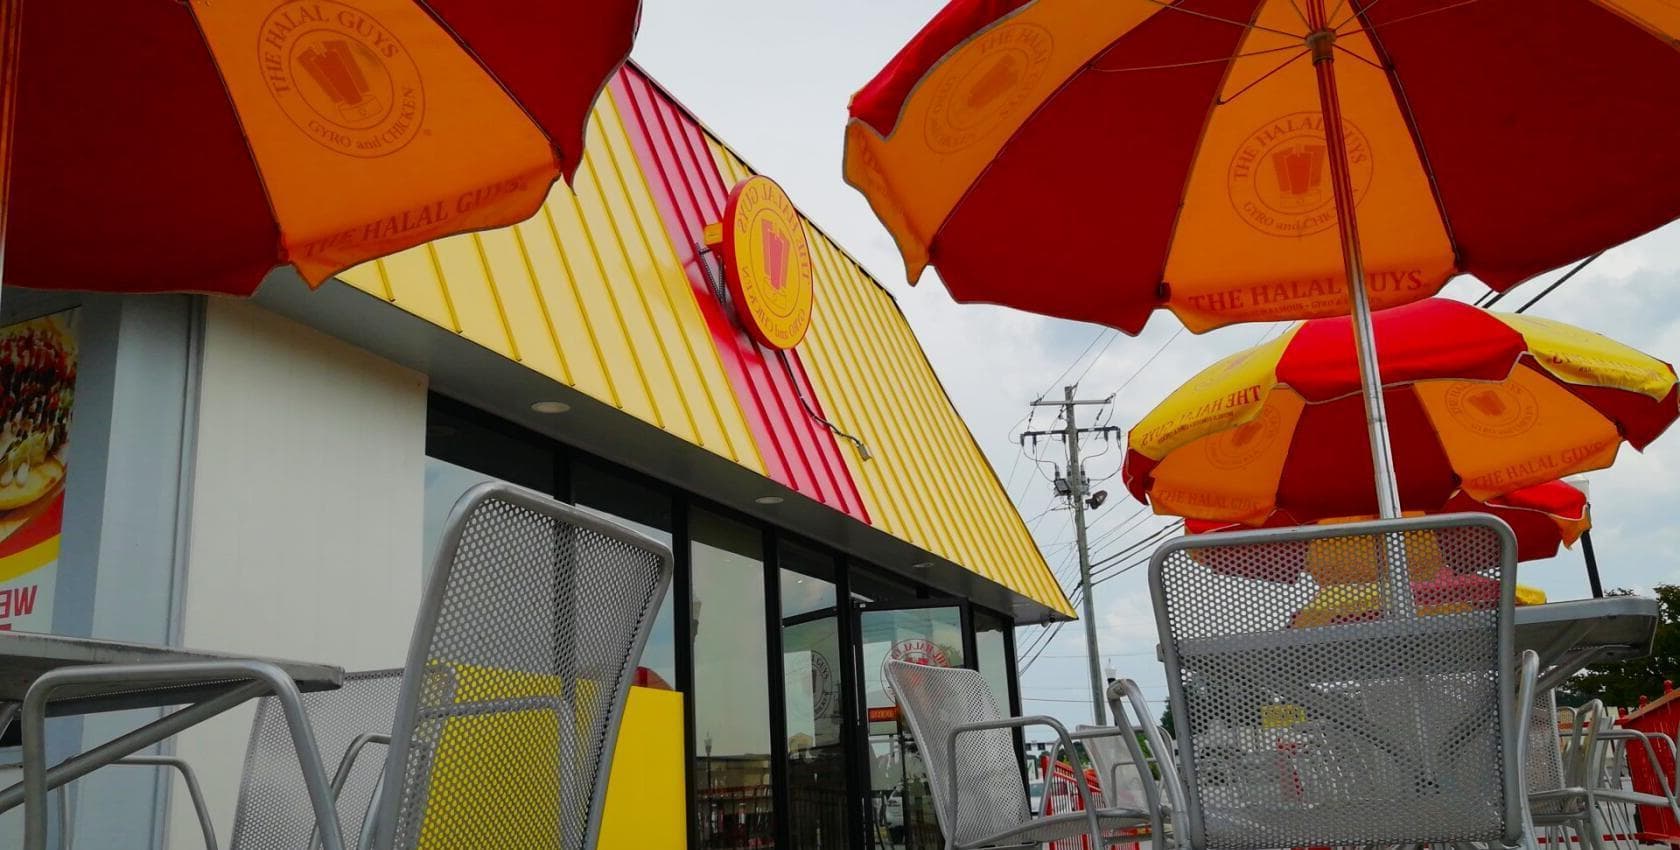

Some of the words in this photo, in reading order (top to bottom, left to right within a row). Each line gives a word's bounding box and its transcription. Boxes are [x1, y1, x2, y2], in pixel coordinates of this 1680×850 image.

[264, 4, 330, 51] HALAL
[336, 10, 399, 58] GUYS
[264, 52, 291, 98] THE
[307, 120, 352, 149] GYRO
[356, 135, 383, 150] and
[382, 86, 417, 145] CHICKEN
[1232, 145, 1259, 182] THE
[362, 200, 449, 241] HALAL
[1242, 200, 1275, 227] GYRO
[1187, 288, 1244, 313] THE
[1250, 277, 1342, 306] HALAL
[1370, 270, 1424, 292] UYS
[1471, 470, 1506, 488] THE
[1505, 455, 1558, 480] HALAL
